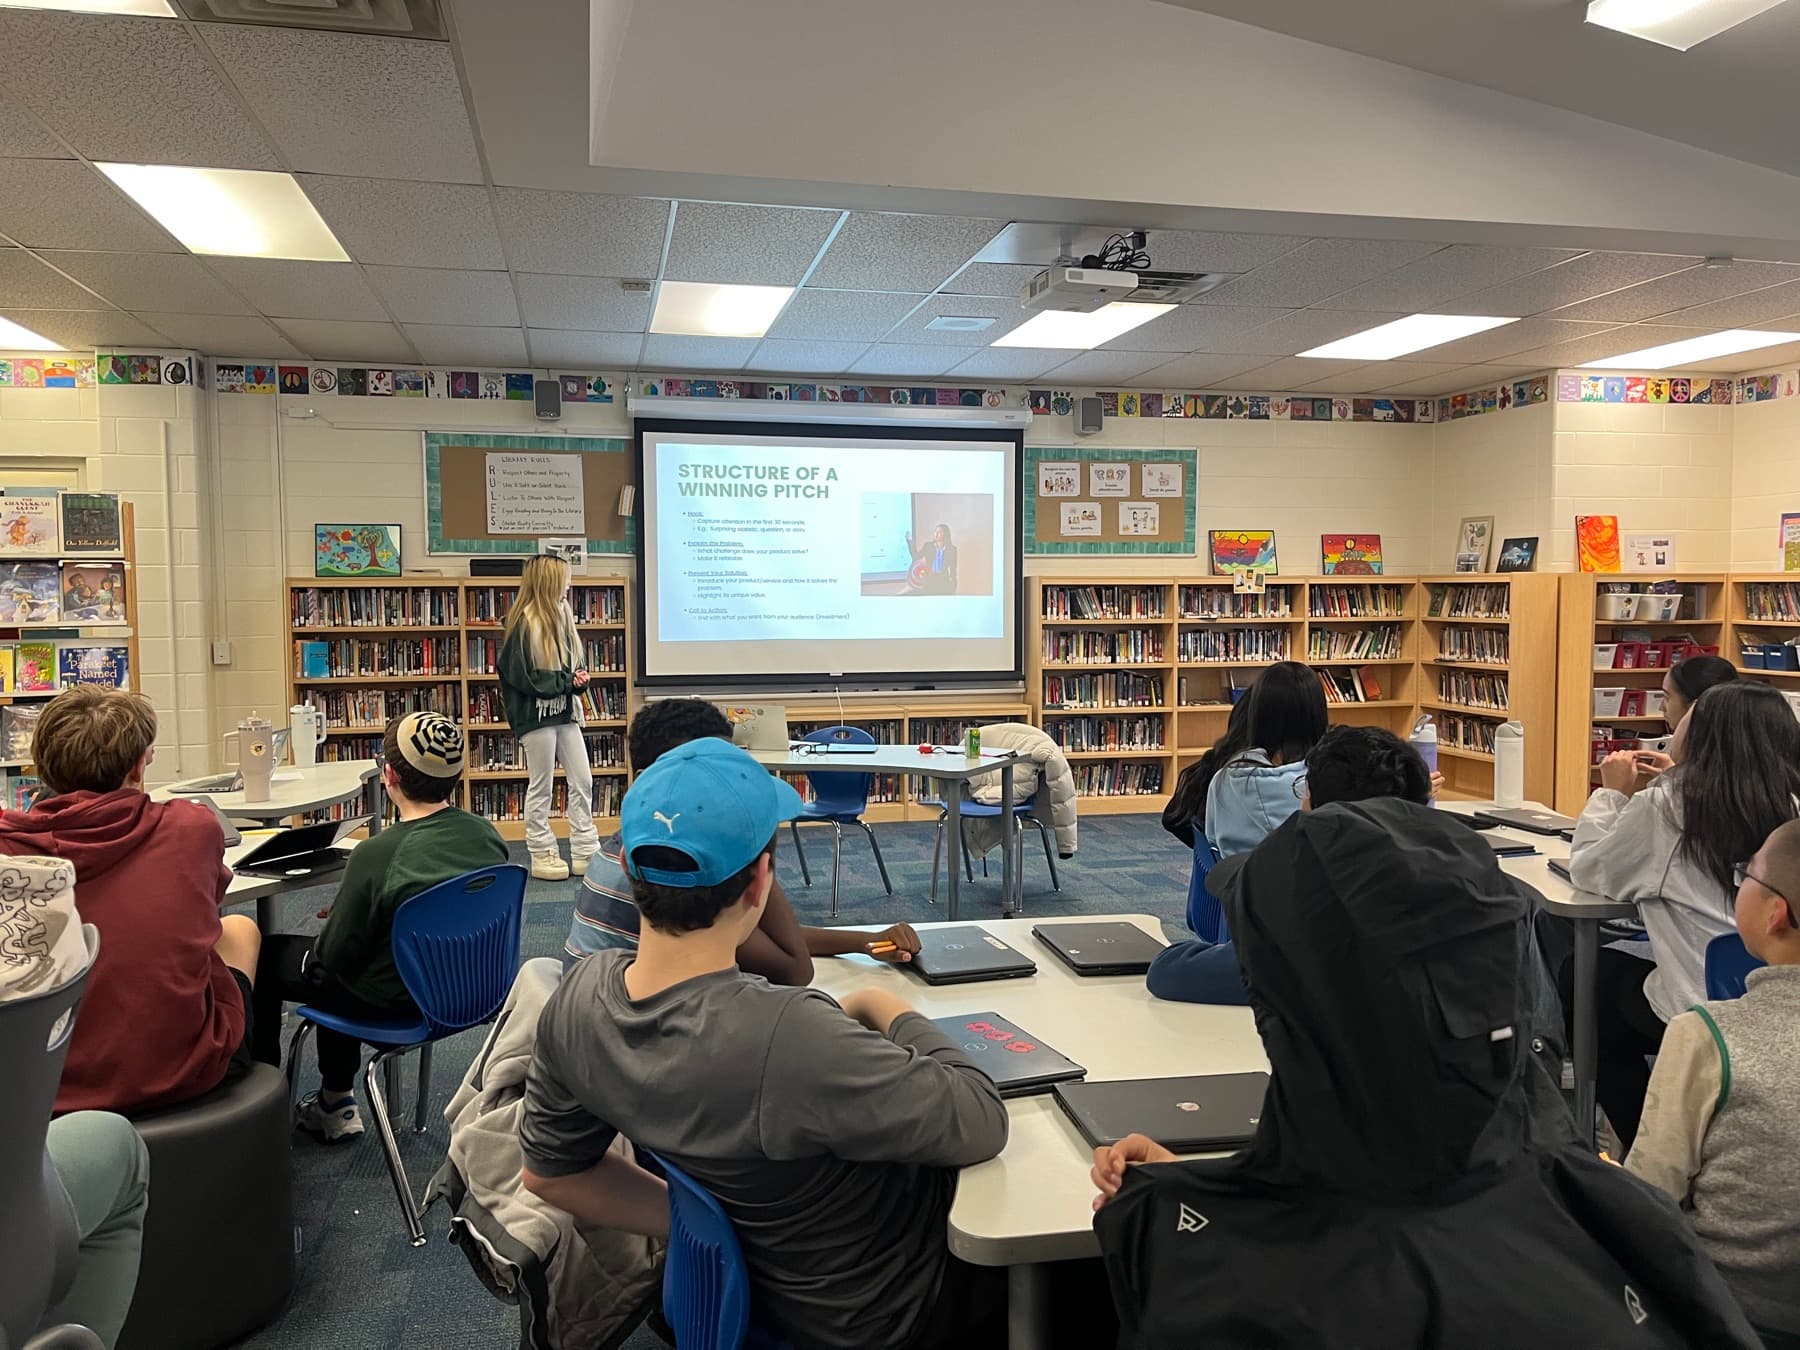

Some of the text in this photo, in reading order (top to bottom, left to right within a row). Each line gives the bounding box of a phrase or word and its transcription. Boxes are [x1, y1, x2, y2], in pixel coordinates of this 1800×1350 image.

[678, 464, 838, 481] STRUCTURE OF A
[678, 482, 829, 498] WINNING PITCH
[80, 670, 118, 679] Named
[77, 679, 115, 688] Didel
